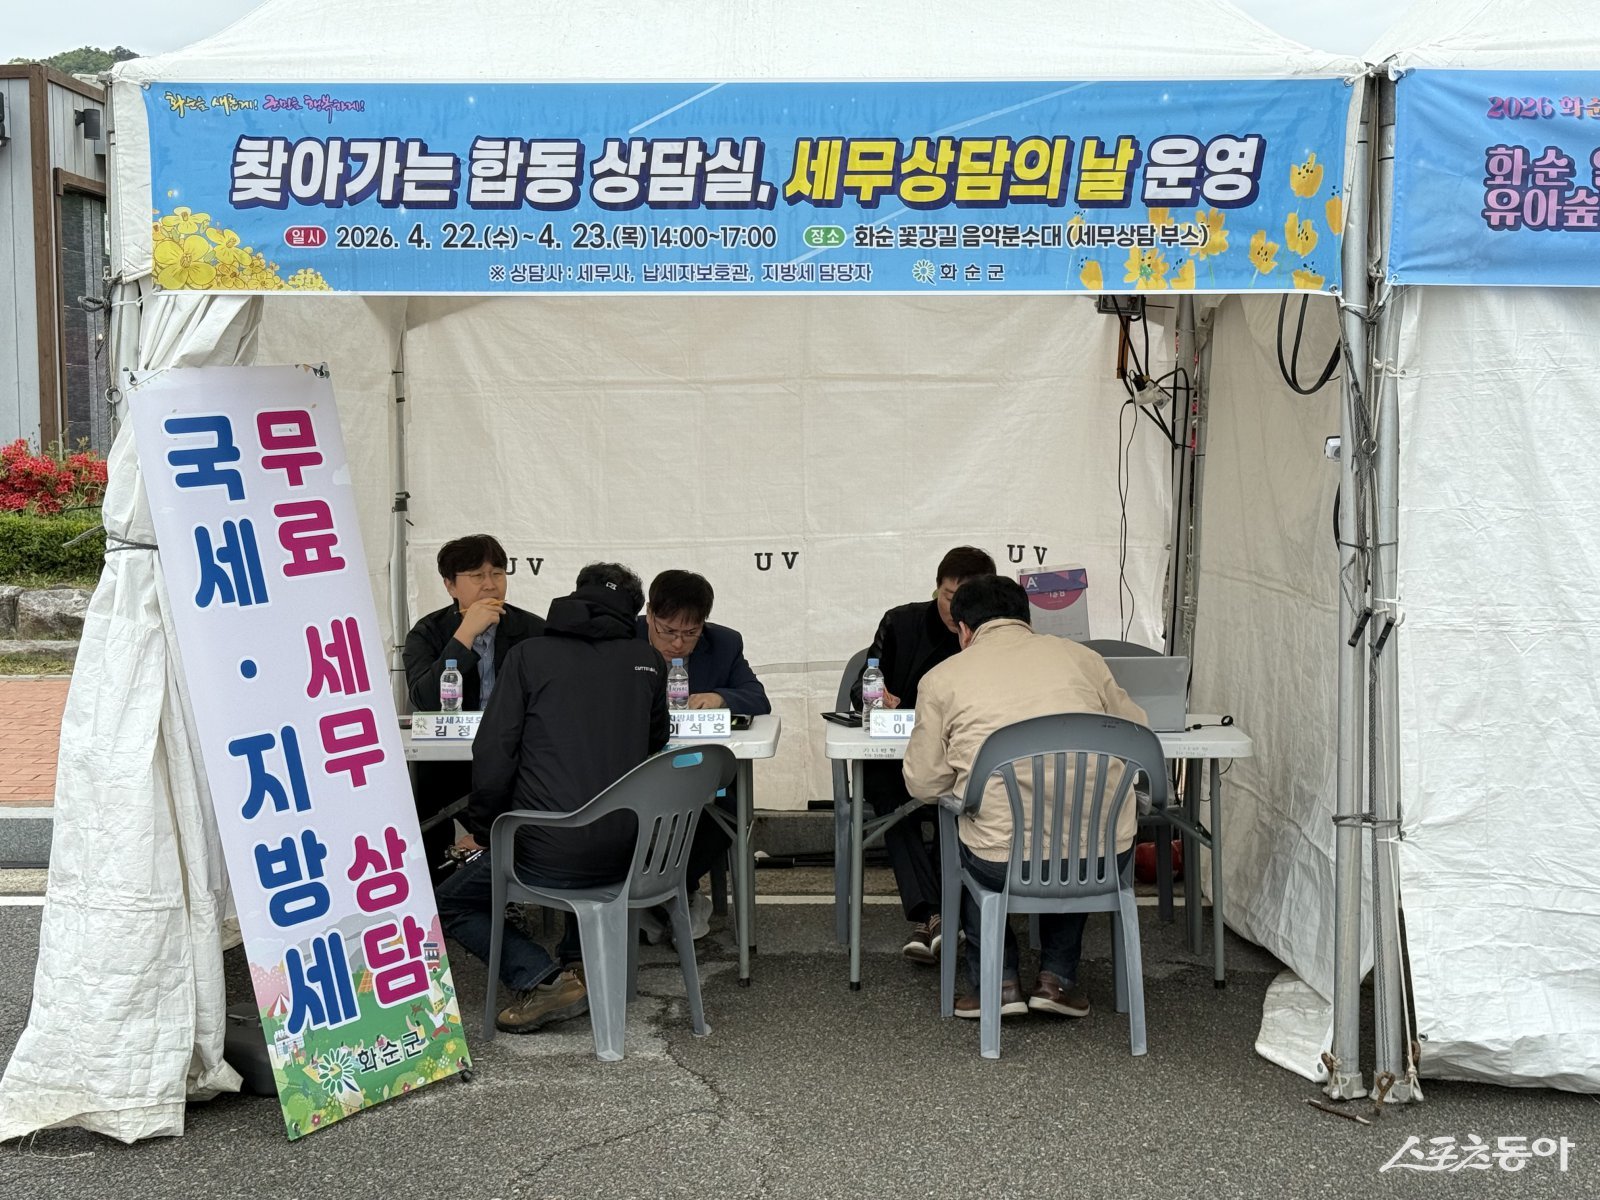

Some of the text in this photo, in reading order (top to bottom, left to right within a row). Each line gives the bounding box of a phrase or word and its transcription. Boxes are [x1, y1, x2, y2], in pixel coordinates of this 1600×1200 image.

[1487, 96, 1555, 119] 2026
[231, 135, 1262, 210] 찾아가는 합동 상담실, 세무상담의 날 운영
[1486, 147, 1571, 186] 화순
[1484, 188, 1600, 228] 유아숲
[291, 228, 321, 245] 일시
[336, 226, 399, 248] 2026.
[408, 223, 431, 248] 4.
[811, 229, 840, 244] 장소
[855, 226, 1210, 247] 화순 꽃강길 음악분수대 (세무상담 부스)
[577, 265, 634, 282] 세무사,
[643, 265, 754, 282] 납세자보호관,
[762, 264, 815, 281] 지방세
[819, 264, 872, 281] 담당자
[256, 409, 346, 578] 무료
[357, 1031, 423, 1073] 화순군
